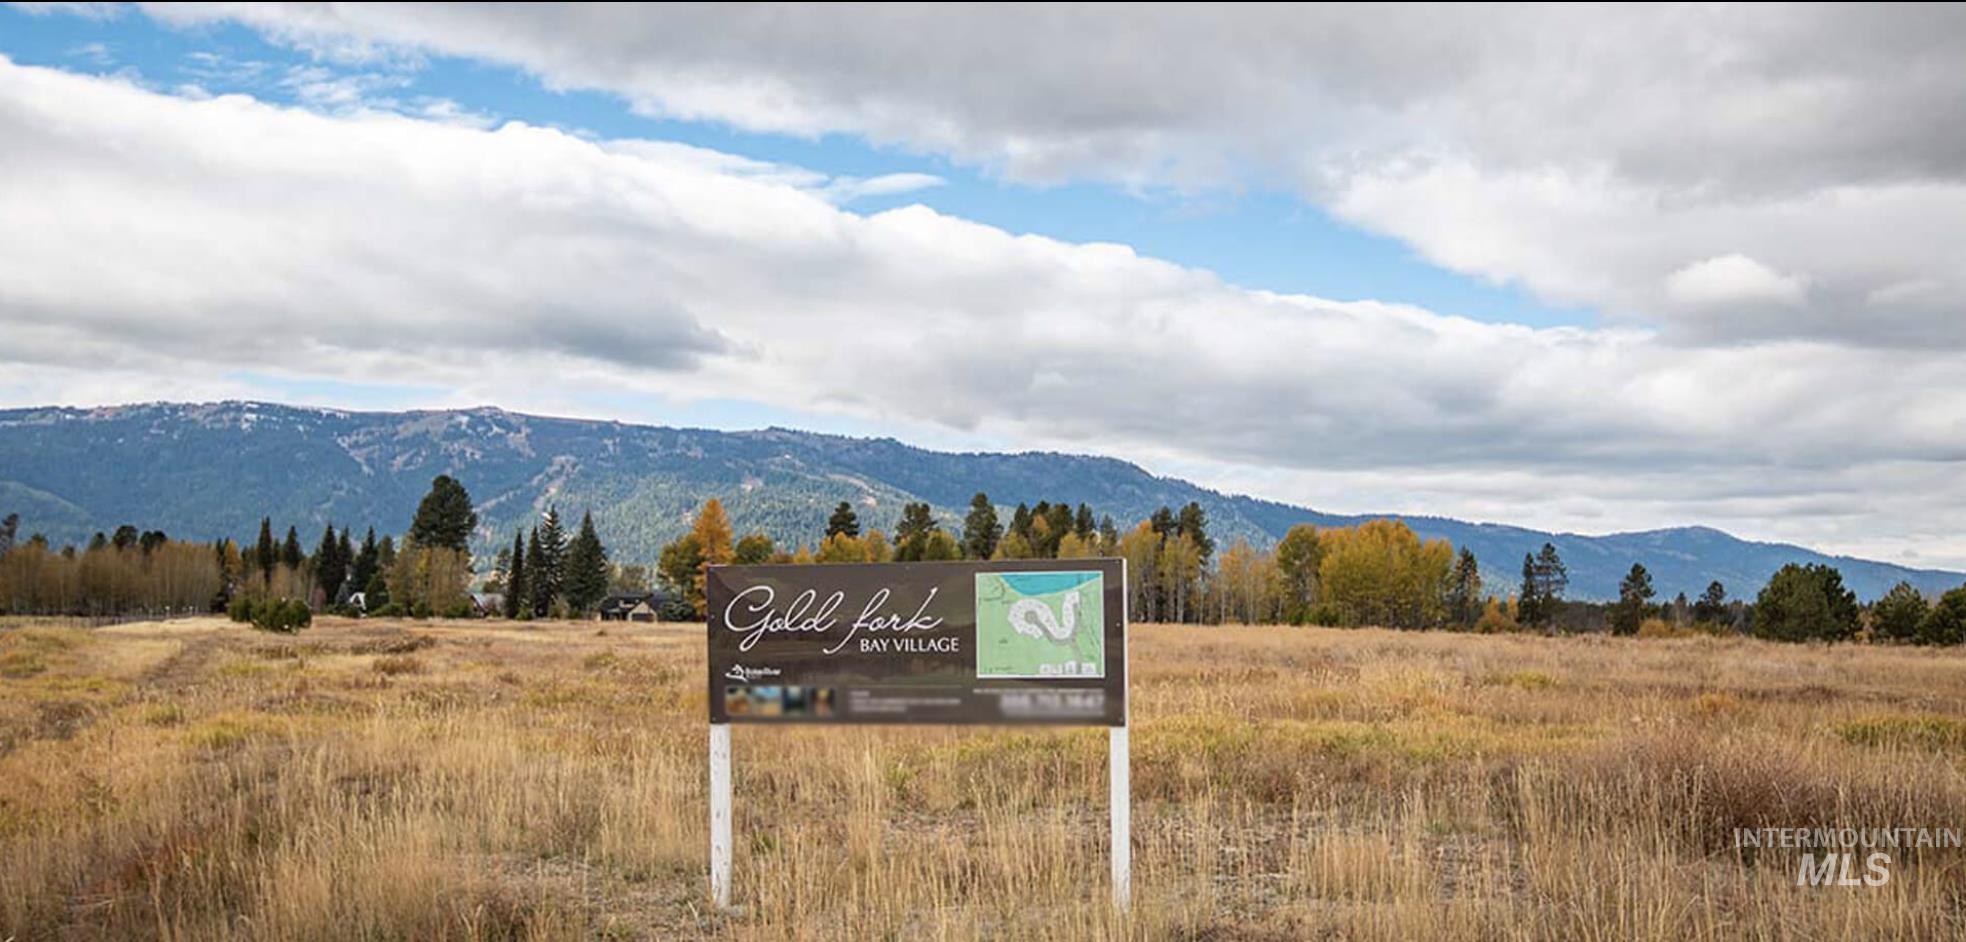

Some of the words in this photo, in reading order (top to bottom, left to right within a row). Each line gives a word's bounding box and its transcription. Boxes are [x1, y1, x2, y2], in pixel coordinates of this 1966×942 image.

[725, 585, 844, 652] Gold
[823, 587, 943, 654] fork
[860, 638, 889, 653] BAY
[892, 637, 960, 653] VILLAGE
